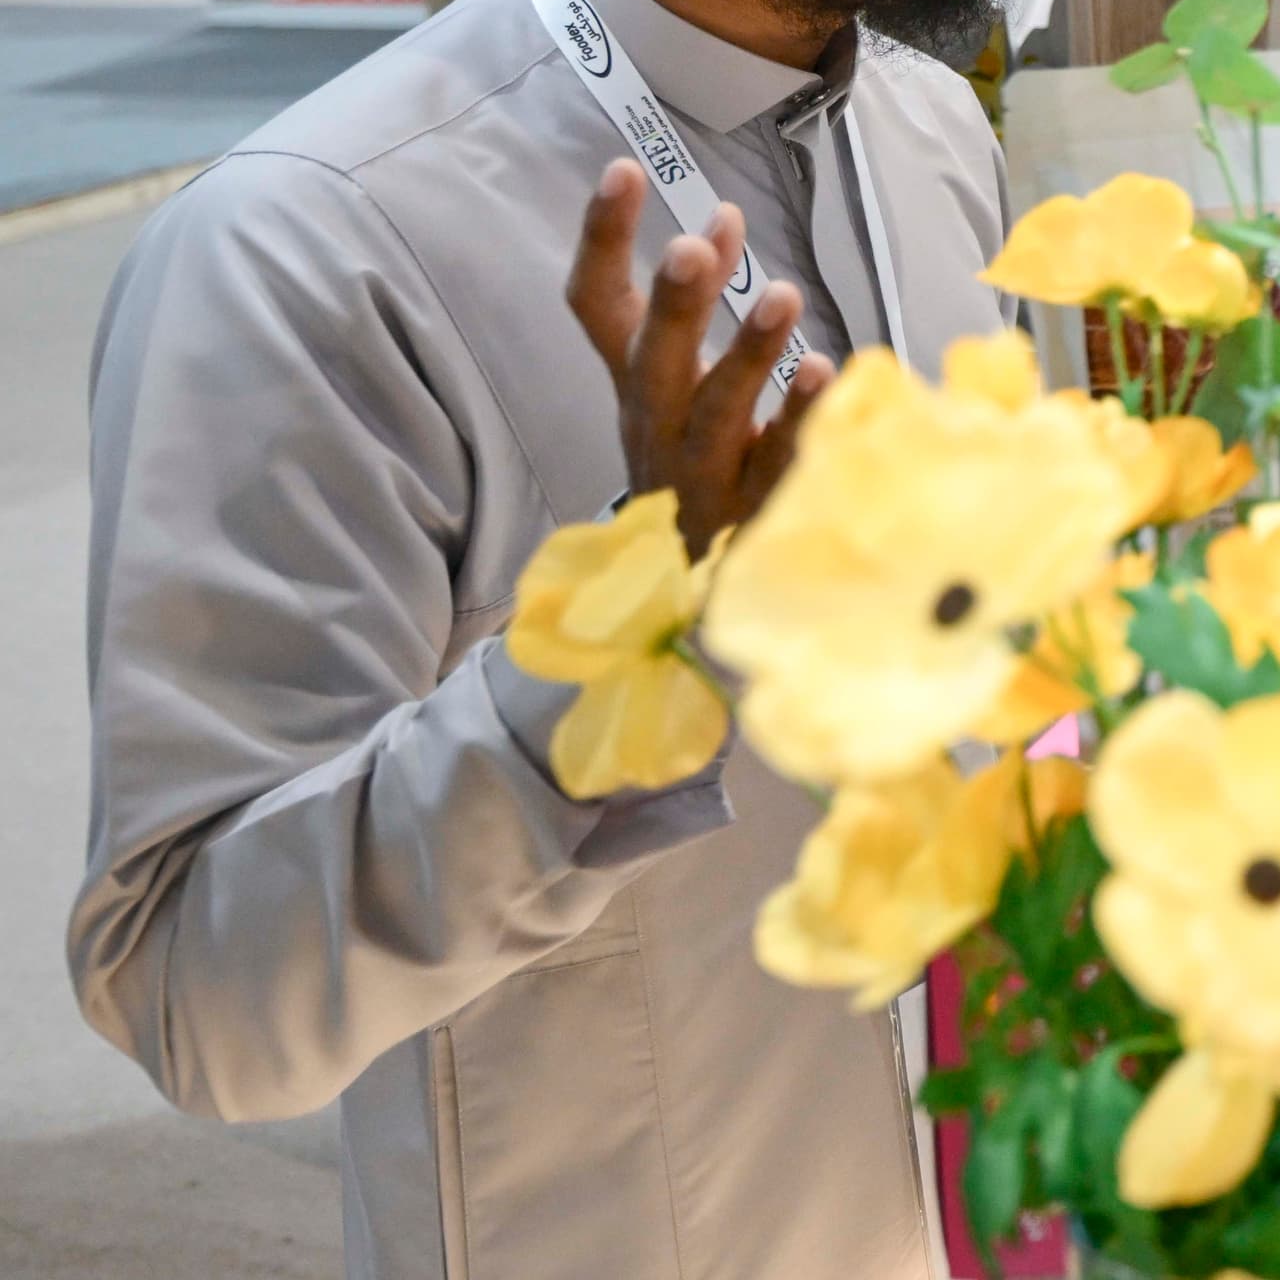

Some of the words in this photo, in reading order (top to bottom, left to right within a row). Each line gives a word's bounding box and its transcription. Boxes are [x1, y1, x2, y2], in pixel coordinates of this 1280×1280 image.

[564, 22, 598, 62] Foodex
[642, 115, 657, 134] Expo
[641, 136, 687, 185] SFE
